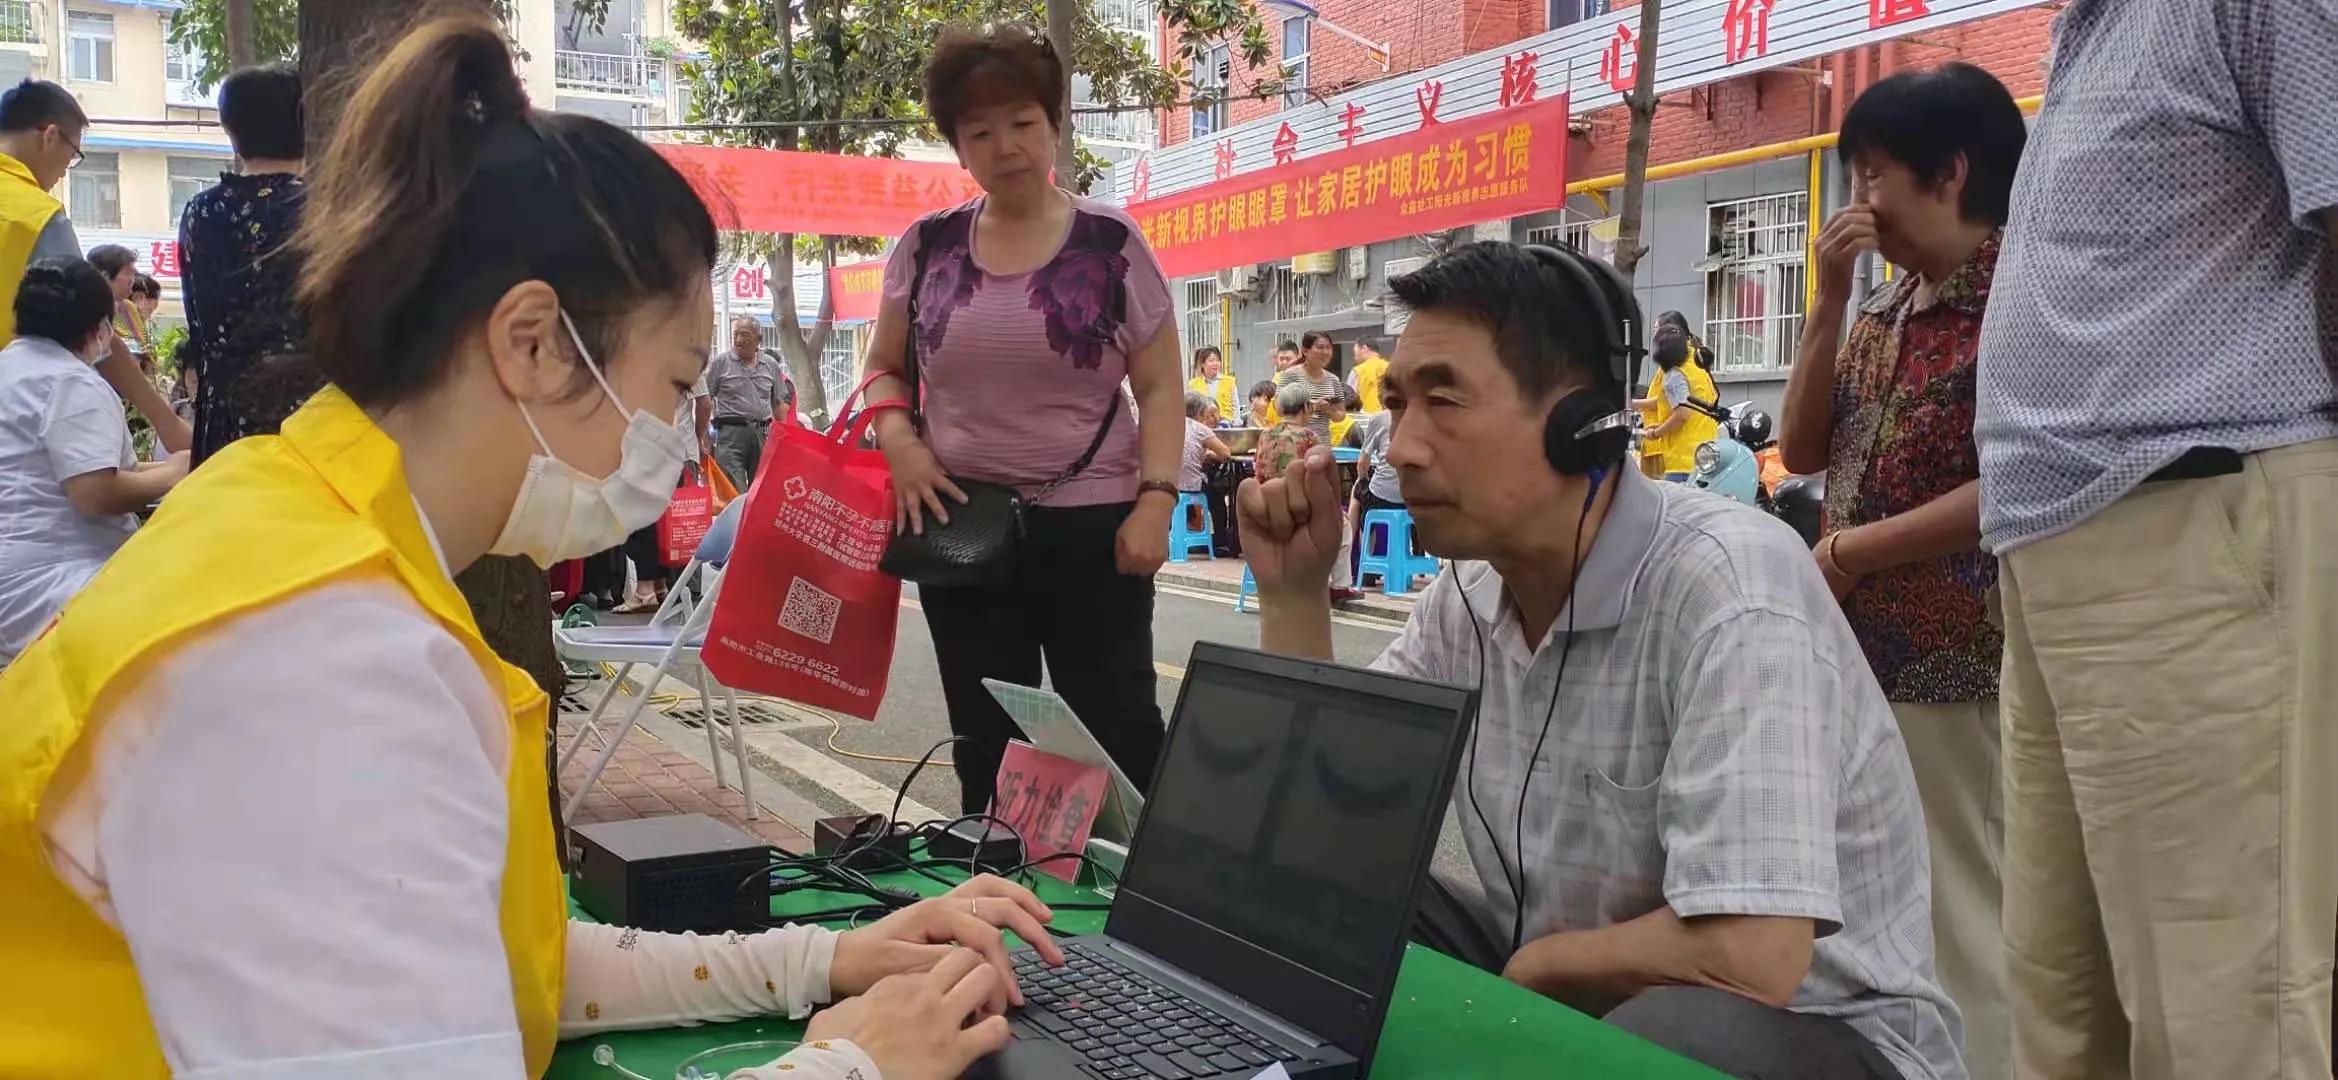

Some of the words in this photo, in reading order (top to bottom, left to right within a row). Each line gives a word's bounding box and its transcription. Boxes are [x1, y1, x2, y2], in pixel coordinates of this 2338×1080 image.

[1294, 122, 1532, 220] 让家居护眼成为习惯
[733, 266, 764, 299] 创
[773, 648, 805, 664] 6229
[807, 658, 839, 676] 6622
